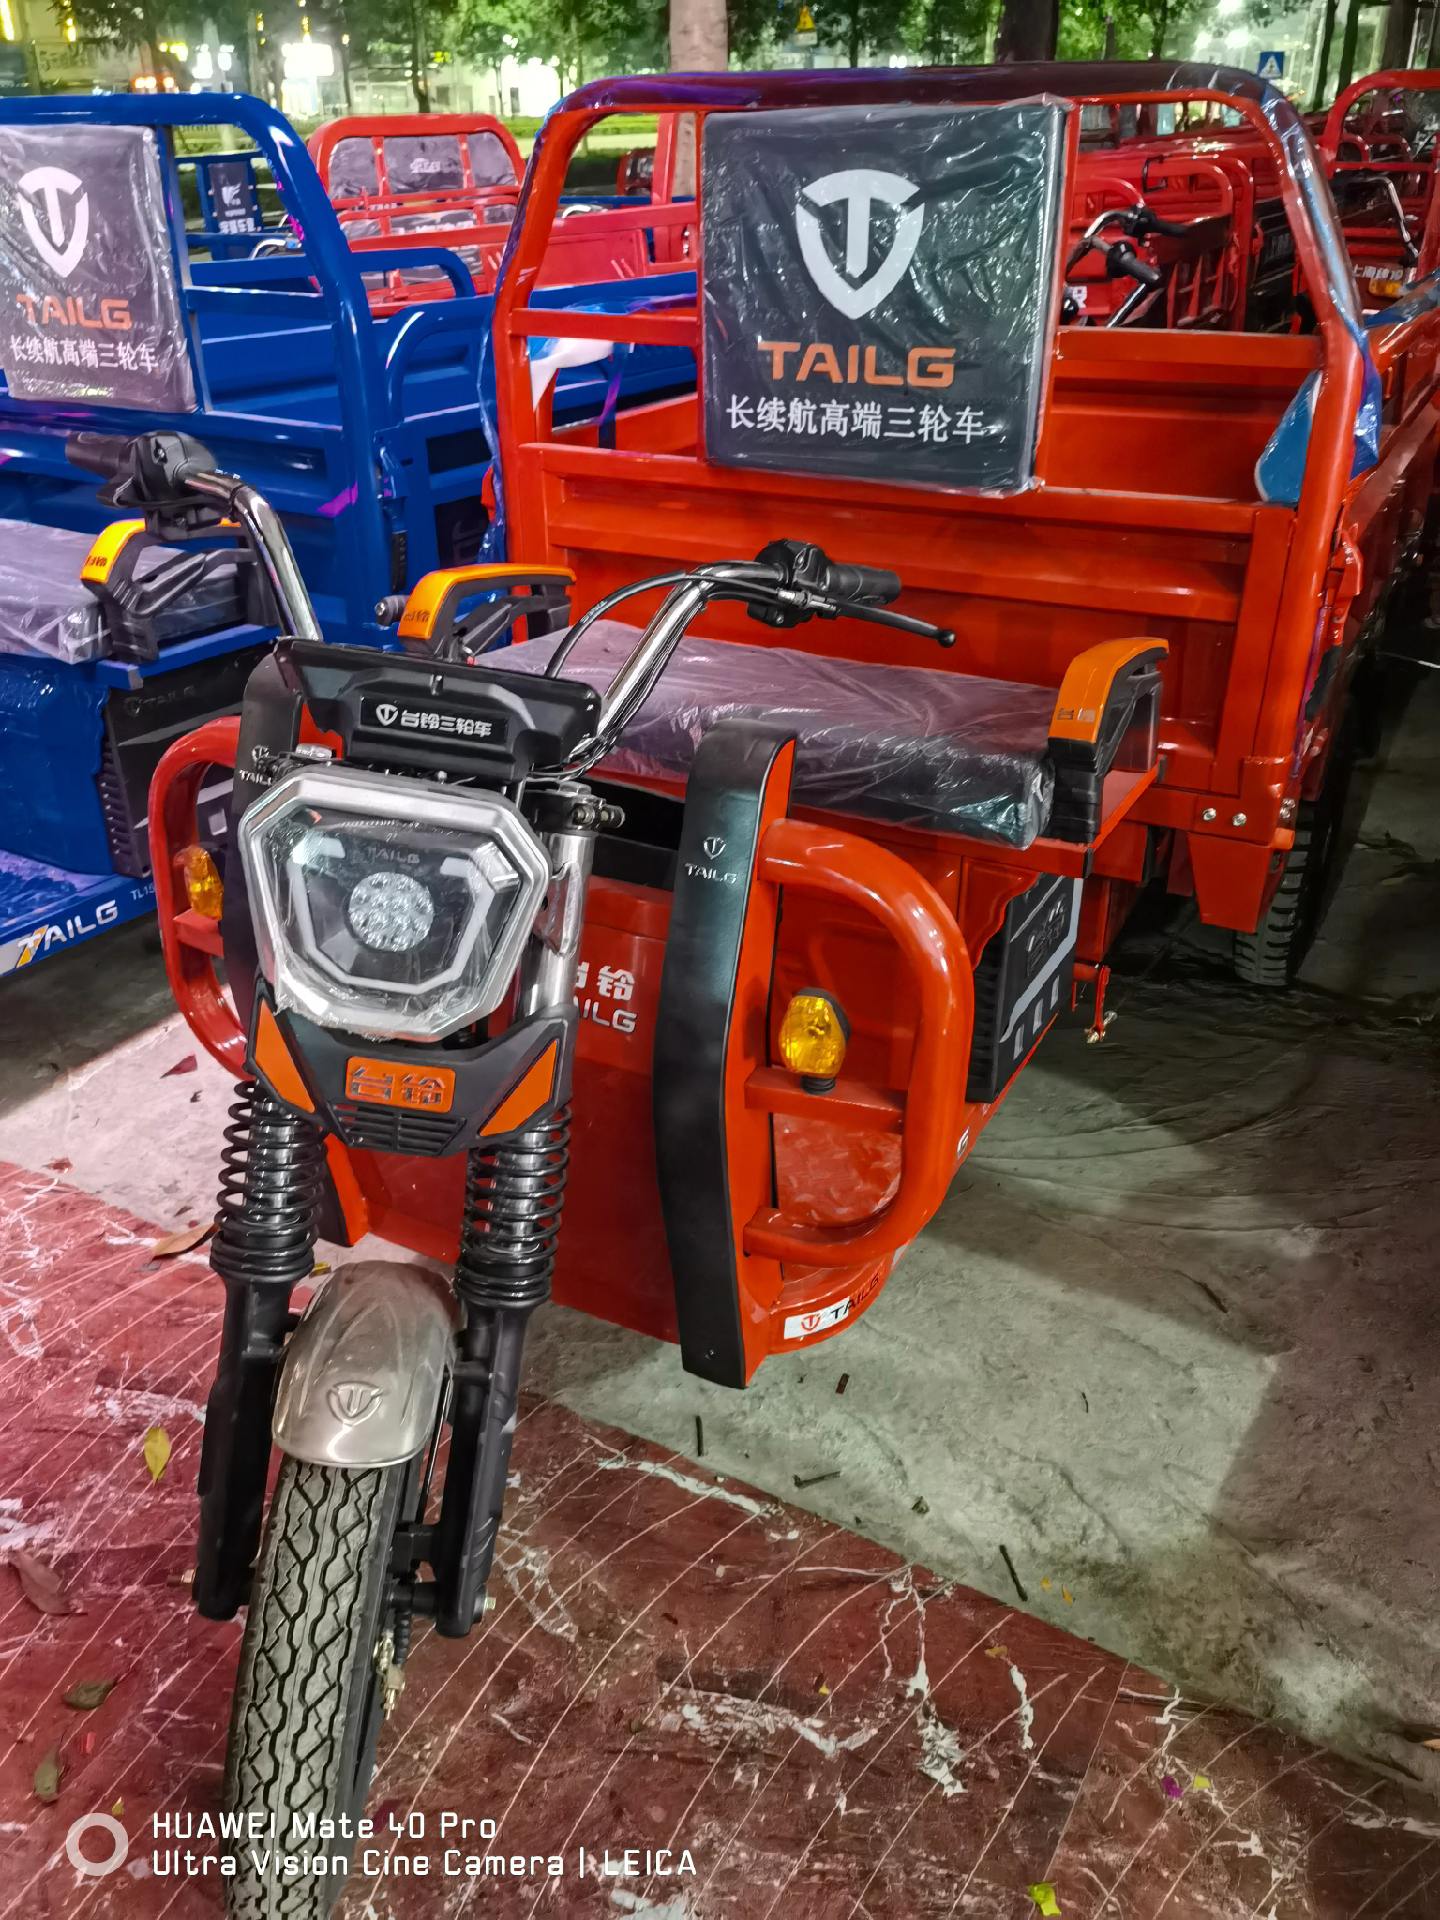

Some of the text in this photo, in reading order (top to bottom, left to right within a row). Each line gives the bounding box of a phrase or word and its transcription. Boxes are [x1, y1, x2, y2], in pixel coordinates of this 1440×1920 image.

[16, 294, 133, 329] TAILG
[9, 334, 159, 373] 长续航高端三轮车
[757, 340, 956, 388] TAILG
[726, 394, 985, 444] 长续航高端三轮车
[400, 709, 493, 738] 台铃三轮车
[685, 862, 738, 885] TAILG
[16, 900, 118, 965] TAILG
[351, 1067, 446, 1104] 台铃
[830, 1272, 879, 1319] TAILG
